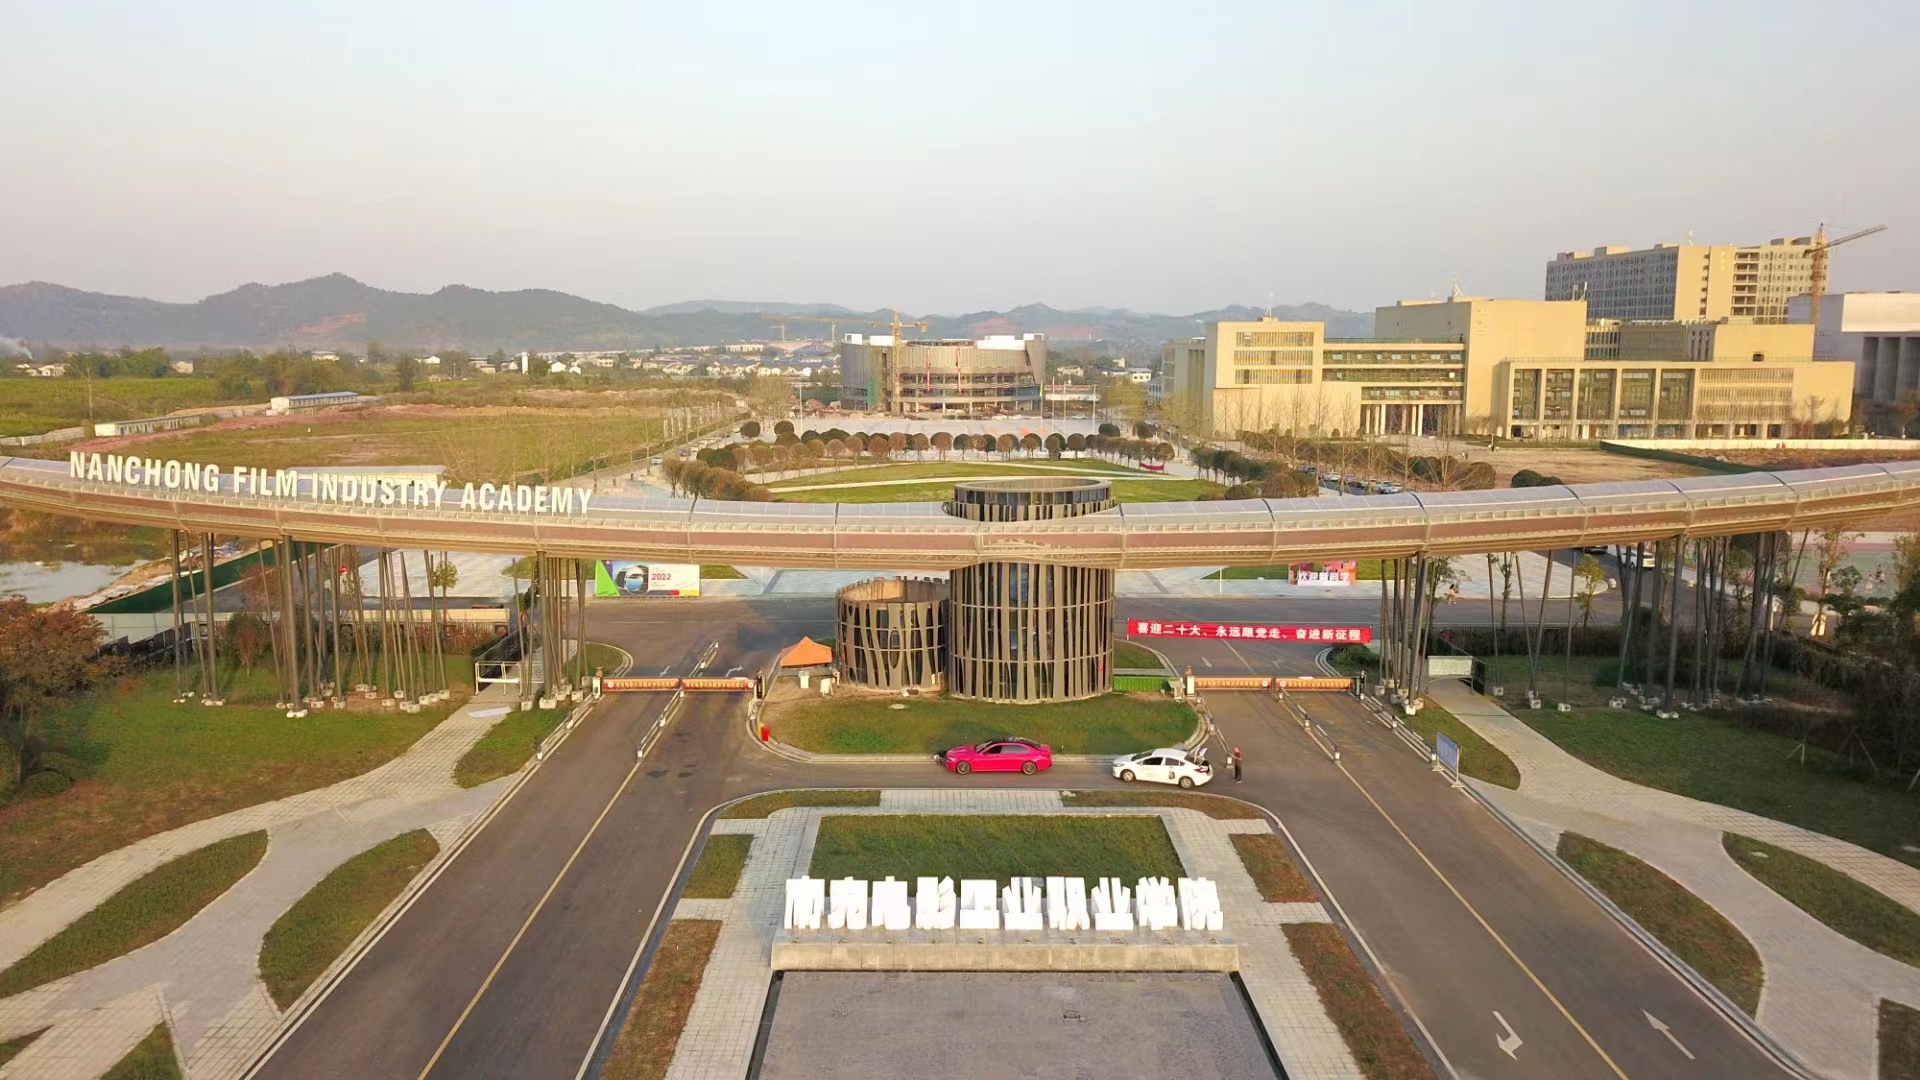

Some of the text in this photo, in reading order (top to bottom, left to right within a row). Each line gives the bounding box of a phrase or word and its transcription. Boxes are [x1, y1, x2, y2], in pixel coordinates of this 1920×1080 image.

[70, 452, 592, 515] NANCHONG FILM INDUSTRY ACADEMY
[651, 573, 671, 581] 2022
